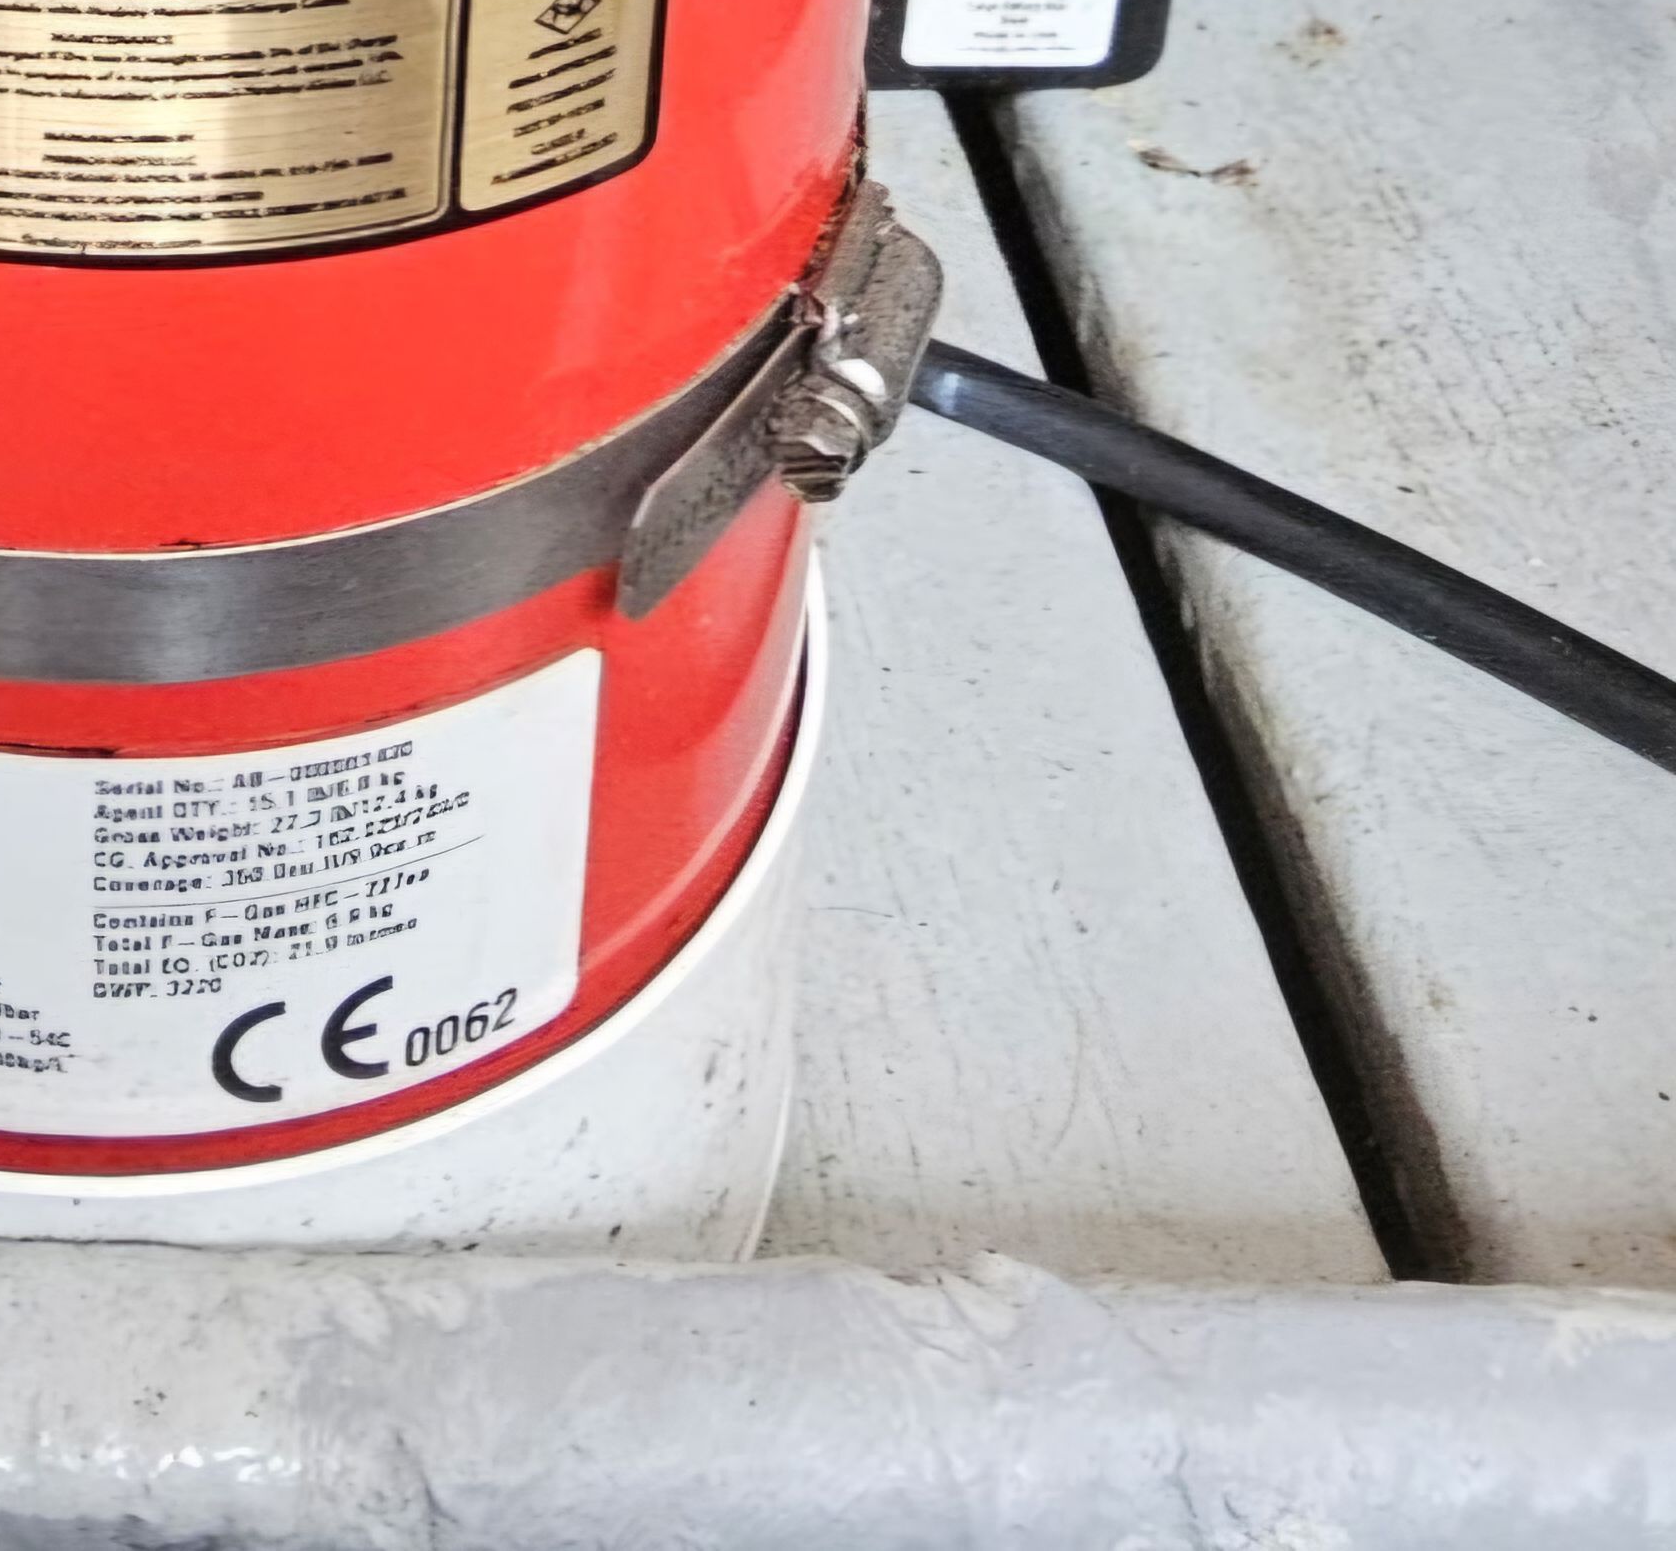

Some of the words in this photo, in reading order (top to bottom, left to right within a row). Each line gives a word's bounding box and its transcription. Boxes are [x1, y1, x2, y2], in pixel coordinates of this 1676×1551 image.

[93, 912, 194, 929] Contains
[93, 934, 151, 952] Total
[93, 958, 151, 975] Total
[212, 975, 394, 1102] CE
[405, 986, 518, 1067] 0062
